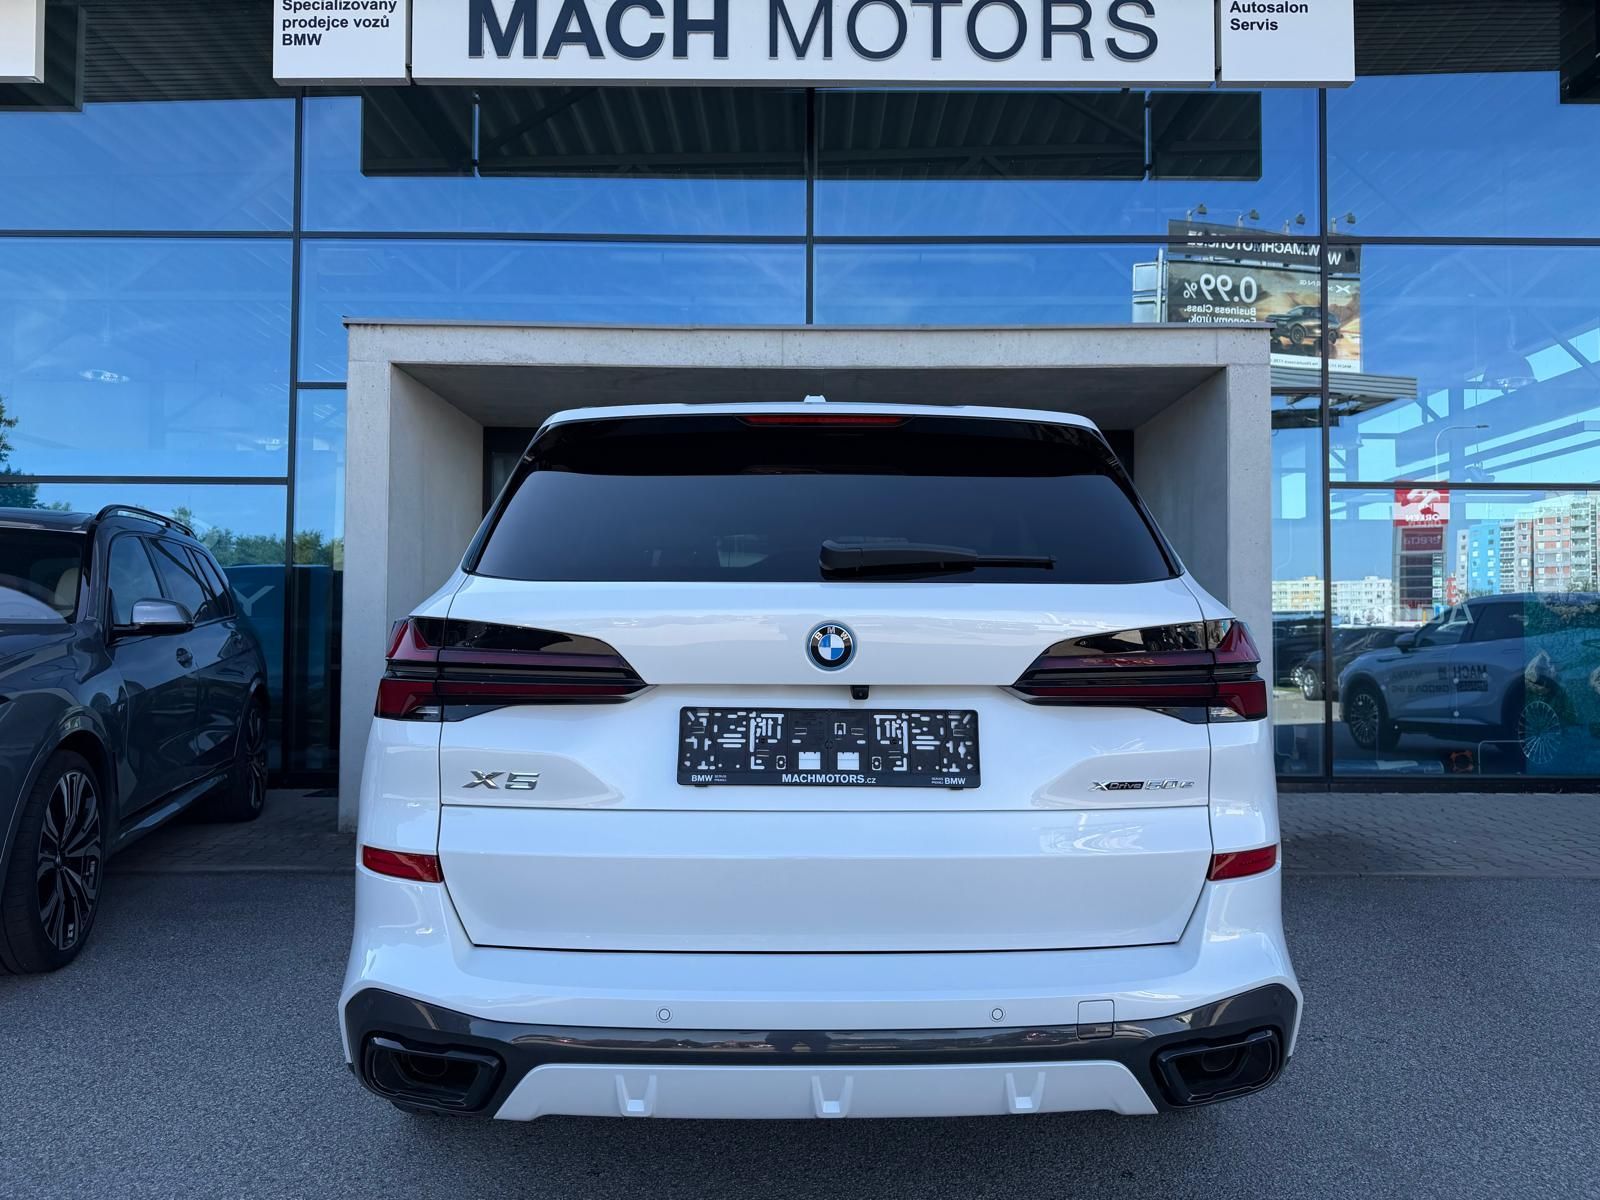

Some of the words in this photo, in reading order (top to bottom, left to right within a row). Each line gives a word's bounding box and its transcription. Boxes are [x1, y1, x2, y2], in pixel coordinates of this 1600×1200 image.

[1230, 0, 1309, 13] Autosalon
[282, 16, 349, 31] prodejce
[353, 15, 390, 28] vozů
[1230, 18, 1278, 31] Servis
[468, 0, 729, 59] MACH
[768, 0, 1159, 62] MOTORS
[282, 33, 322, 46] BMW
[814, 626, 849, 641] BMW
[461, 770, 541, 791] X5
[691, 774, 713, 782] BMW
[944, 777, 966, 785] BMW
